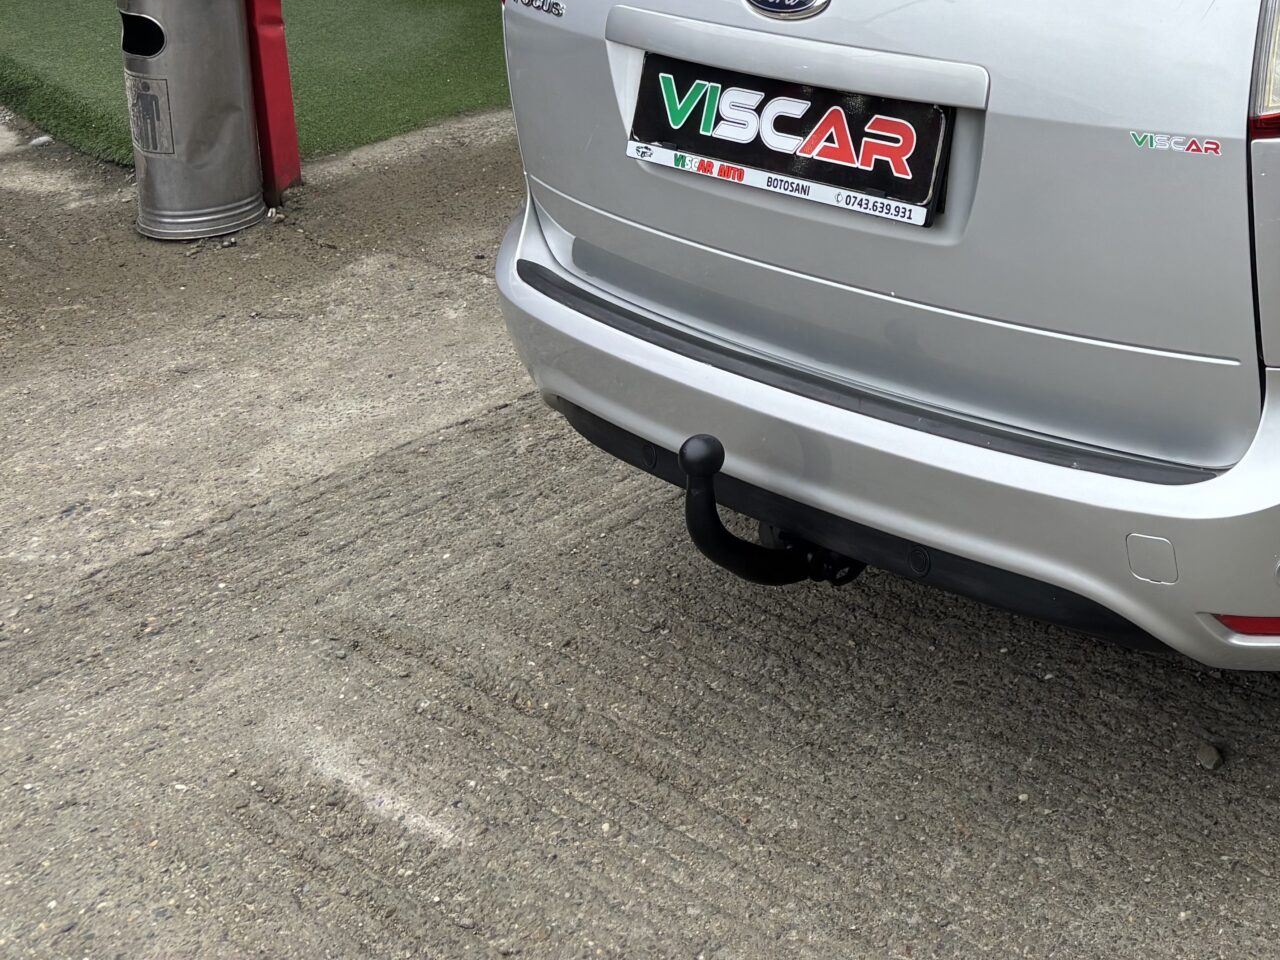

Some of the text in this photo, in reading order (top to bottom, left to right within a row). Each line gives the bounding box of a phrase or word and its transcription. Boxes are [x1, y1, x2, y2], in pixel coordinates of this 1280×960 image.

[658, 72, 916, 181] VISCAR
[1129, 131, 1222, 156] VISCAR
[673, 152, 745, 183] VISCAR AUTO
[766, 176, 913, 221] BOTOSANI 0743.639.931
